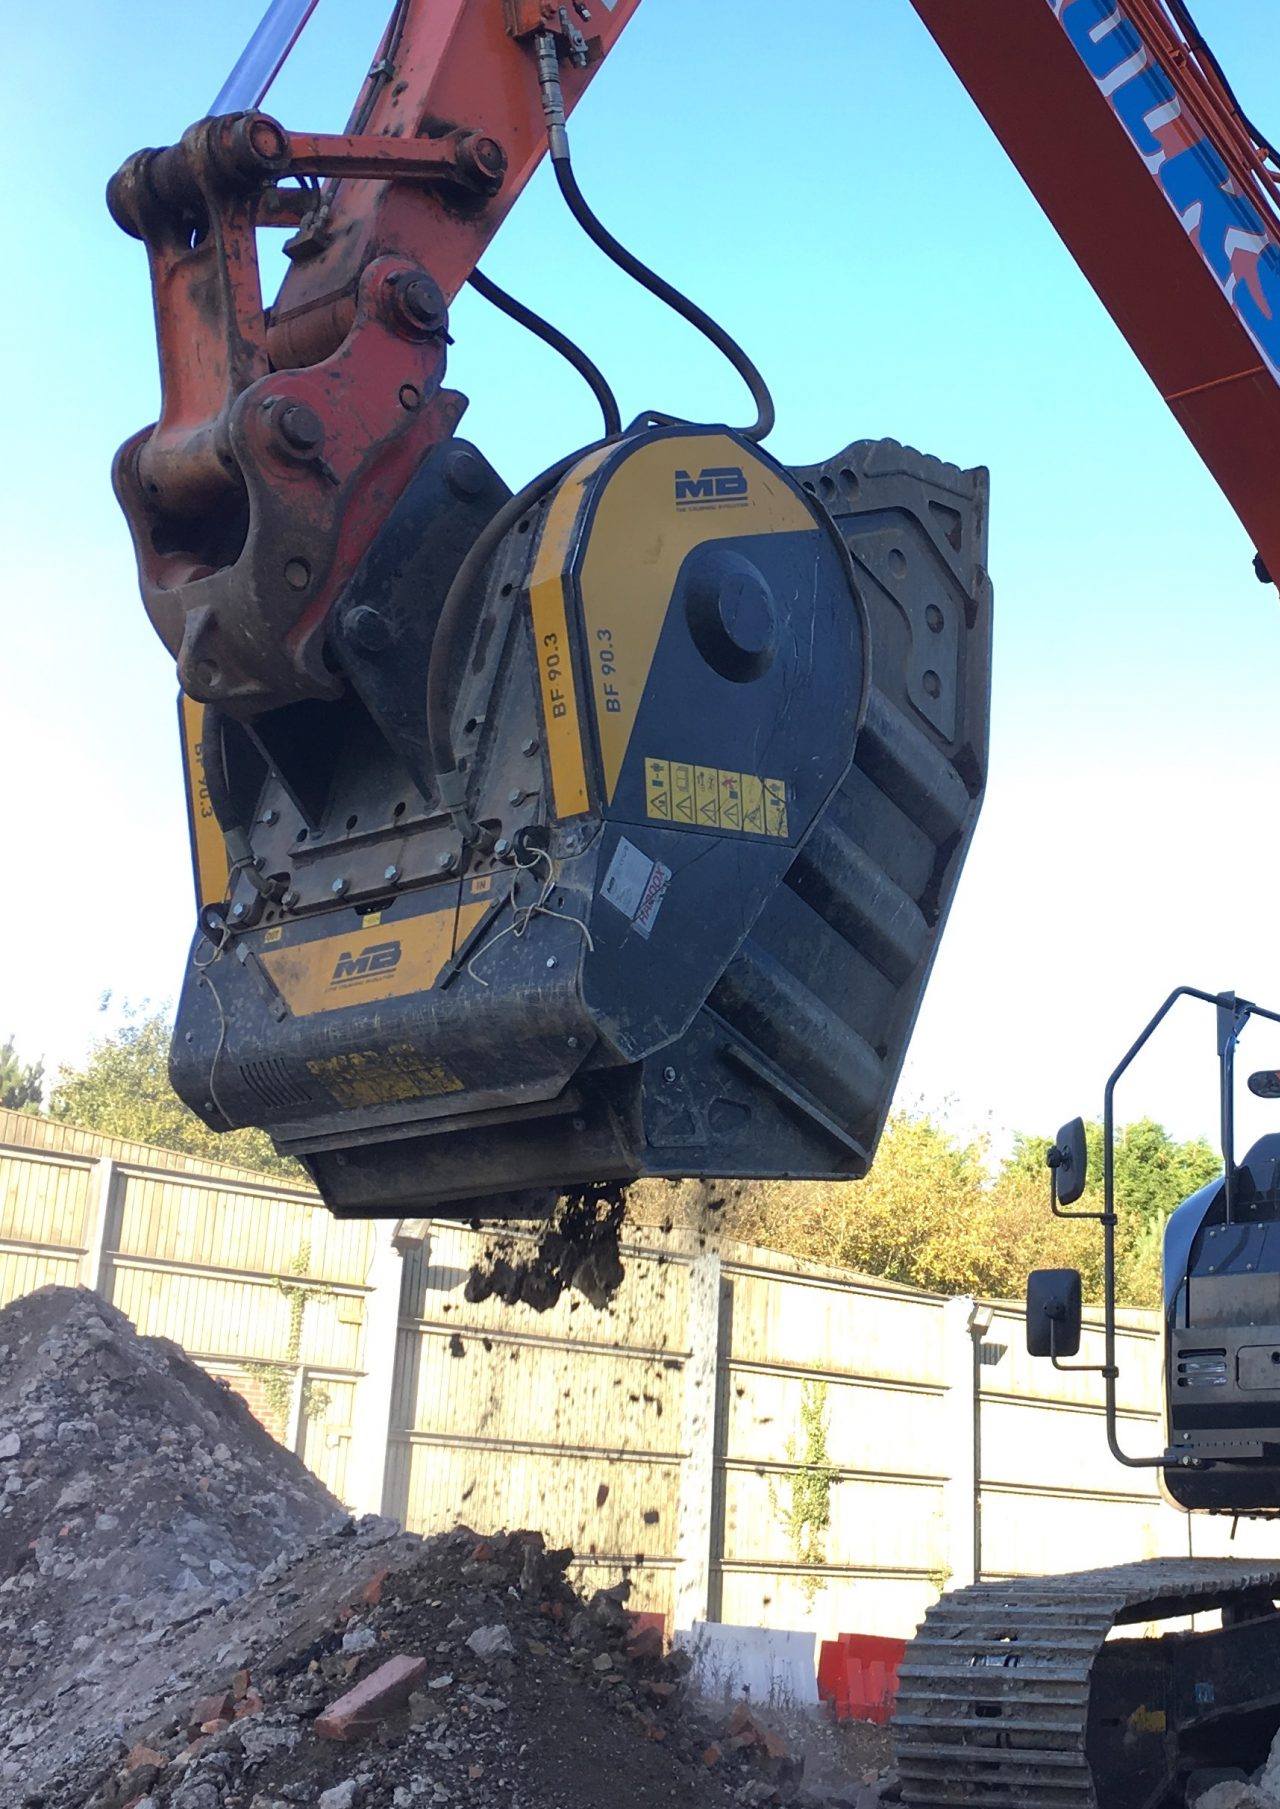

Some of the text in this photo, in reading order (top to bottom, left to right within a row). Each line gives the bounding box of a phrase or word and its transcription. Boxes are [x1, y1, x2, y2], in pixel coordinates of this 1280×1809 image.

[675, 467, 748, 498] MB
[543, 633, 566, 718] BF 90.3
[597, 629, 621, 713] BF 90.3
[475, 878, 487, 891] IN
[332, 940, 402, 980] MB
